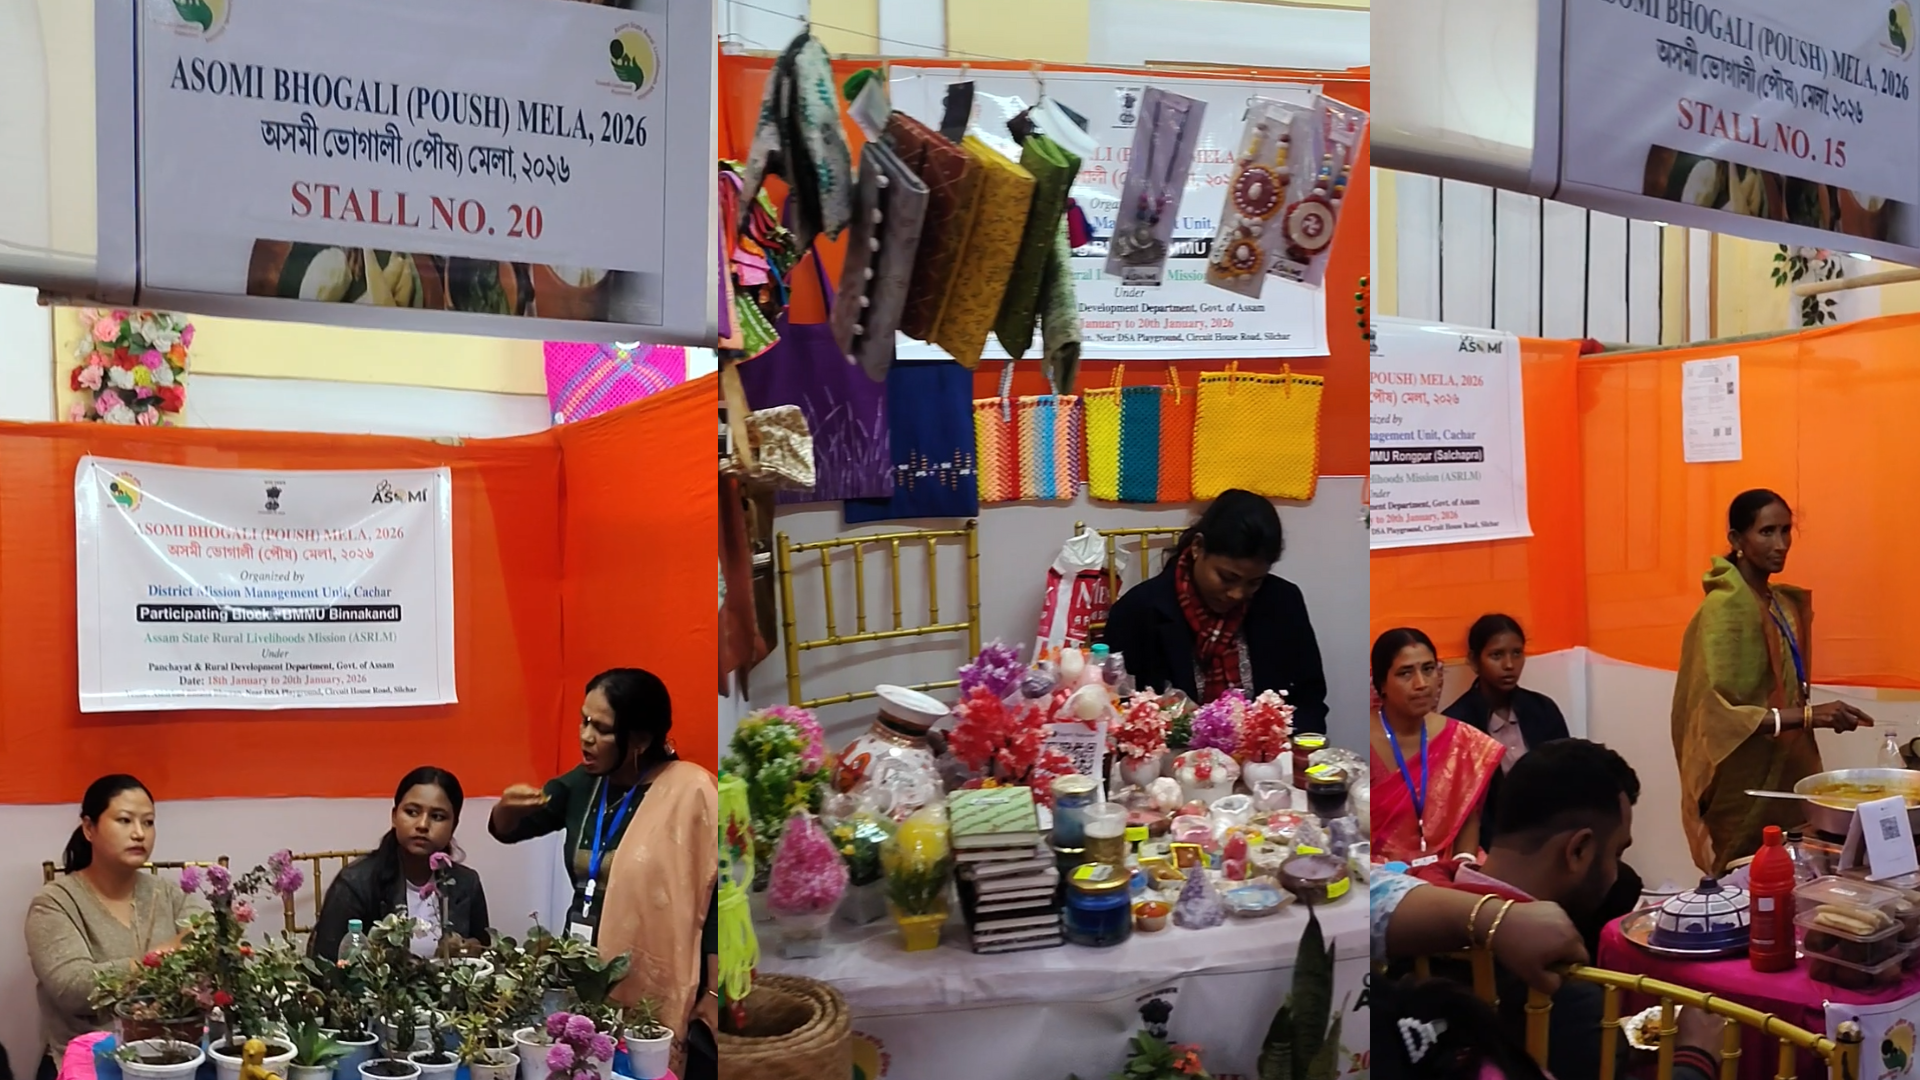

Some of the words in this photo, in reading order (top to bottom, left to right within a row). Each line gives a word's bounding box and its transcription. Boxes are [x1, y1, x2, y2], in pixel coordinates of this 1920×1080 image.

[1666, 0, 1753, 50] BHOGALI
[1758, 26, 1828, 80] (POUSH)
[1831, 49, 1878, 96] MELA,
[1881, 67, 1909, 101] 2026
[170, 55, 265, 100] ASOMI
[273, 67, 400, 117] BHOGALI
[406, 86, 510, 138] (POUSH)
[517, 99, 594, 148] MELA,
[600, 110, 648, 147] 2026
[1677, 97, 1769, 149] STALL
[1772, 122, 1817, 162] NO.
[1824, 137, 1847, 168] 15
[261, 111, 319, 156] অসমী
[323, 122, 403, 166] ভোগালী
[406, 128, 463, 178] (পৌষ)
[468, 144, 518, 184] মেলা,
[521, 151, 571, 186] ২০২৬
[290, 179, 420, 228] STALL
[428, 194, 495, 236] NO.
[506, 203, 543, 240] 20
[1182, 216, 1216, 232] Unit,
[1167, 269, 1204, 281] Missio
[1114, 287, 1145, 298] Under
[1078, 302, 1139, 314] Development
[1141, 302, 1197, 314] Department,
[1200, 303, 1223, 313] Govt.
[1226, 302, 1235, 312] of
[1237, 302, 1265, 312] Assam
[1125, 319, 1135, 329] to
[1138, 318, 1160, 329] 20th
[1163, 318, 1207, 330] January,
[1210, 317, 1234, 328] 2026
[1117, 333, 1135, 341] DSA
[1137, 333, 1184, 343] Playground,
[1185, 332, 1213, 341] Circuit
[1215, 332, 1238, 341] House
[1370, 371, 1417, 386] POUSH)
[1420, 373, 1459, 387] MELA,
[1461, 374, 1484, 387] 2026
[1370, 388, 1397, 407] পৌষ)
[1392, 413, 1403, 426] by
[1370, 430, 1415, 443] nagement
[1417, 429, 1441, 441] Unit,
[1443, 429, 1476, 440] Cachar
[1391, 450, 1432, 463] Rongpur
[1433, 448, 1483, 462] (Salchapra)
[1406, 472, 1439, 482] Mission
[1441, 470, 1481, 481] (ASRLM)
[1388, 501, 1431, 511] Department,
[1451, 498, 1459, 507] of
[1460, 498, 1480, 506] Assam
[1376, 515, 1385, 524] to
[1386, 513, 1404, 523] 20th
[134, 522, 184, 537] ASOMI
[188, 525, 257, 540] BHOGALI
[261, 527, 320, 542] (POUSH)
[324, 528, 372, 541] MELA,
[375, 527, 404, 540] 2026
[167, 540, 202, 558] অসমী
[205, 542, 254, 560] ভোগালী
[341, 547, 375, 561] ২০২৬
[240, 569, 290, 583] Organized
[292, 570, 305, 584] by
[148, 584, 193, 597] District
[198, 585, 241, 598] Mission
[244, 585, 318, 600] Management
[353, 585, 392, 598] Cachar
[140, 606, 228, 623] Participating
[232, 607, 270, 620] Block
[282, 607, 326, 621] BMMU
[329, 606, 399, 621] Binnakandi
[144, 632, 179, 644] Assam
[182, 632, 209, 644] State
[212, 632, 243, 644] Rural
[246, 632, 305, 644] Livelihoods
[308, 632, 346, 643] Mission
[348, 631, 397, 644] (ASRLM)
[261, 648, 289, 659] Under
[148, 662, 192, 673] Panchayat
[194, 663, 202, 671] &
[205, 662, 228, 671] Rural
[230, 662, 283, 673] Development
[285, 662, 334, 672] Department,
[336, 661, 358, 671] Govt.
[359, 661, 368, 670] of
[369, 661, 395, 670] Assam
[179, 675, 205, 686] Date:
[208, 675, 228, 686] 18th
[230, 675, 268, 688] January
[271, 675, 280, 685] to
[282, 675, 301, 685] 20th
[304, 674, 344, 686] January,
[346, 674, 367, 684] 2026
[350, 686, 371, 695] House
